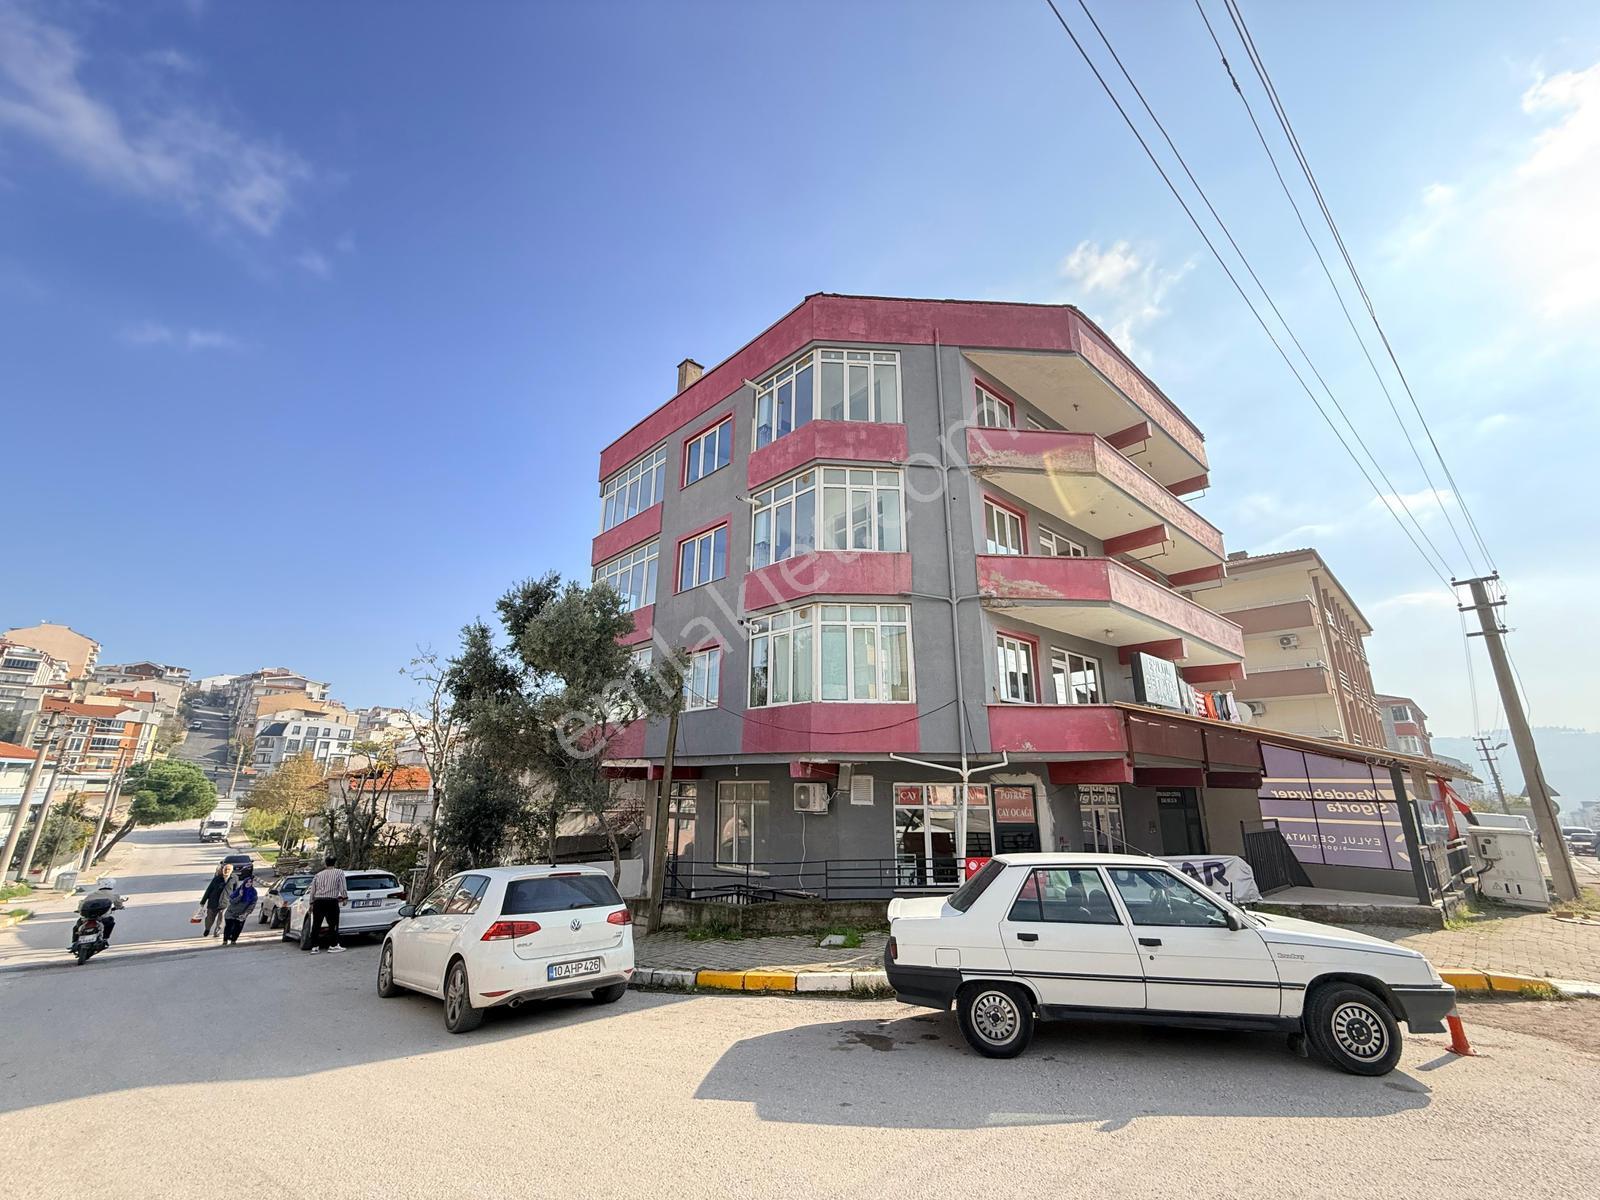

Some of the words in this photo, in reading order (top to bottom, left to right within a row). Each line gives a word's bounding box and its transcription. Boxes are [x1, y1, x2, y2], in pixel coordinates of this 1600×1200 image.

[554, 966, 563, 976] 10
[564, 963, 583, 974] AHP
[584, 960, 599, 971] 426
